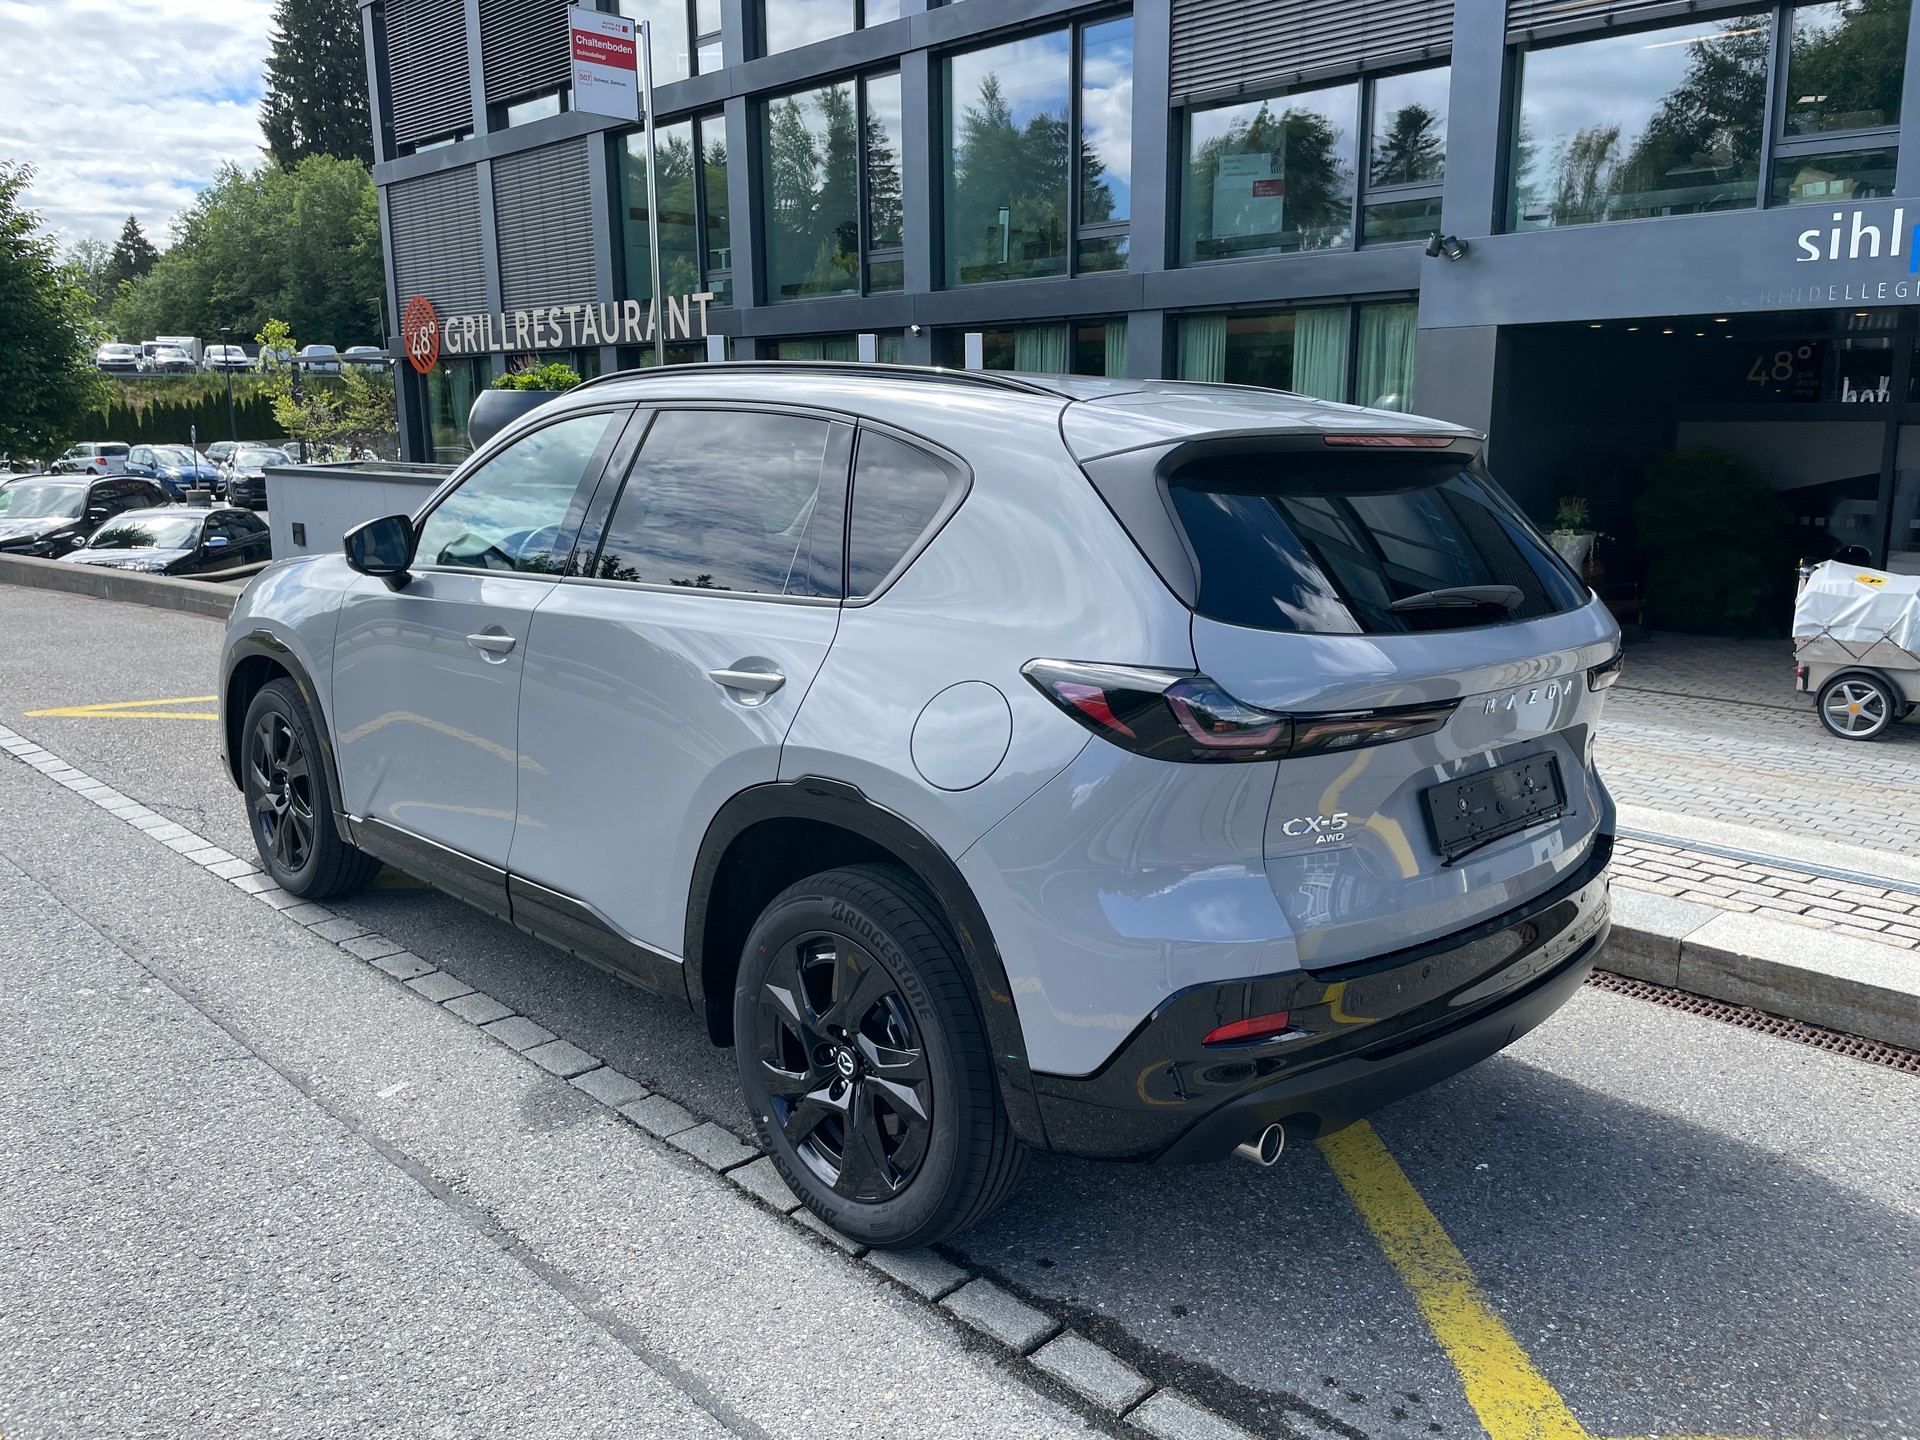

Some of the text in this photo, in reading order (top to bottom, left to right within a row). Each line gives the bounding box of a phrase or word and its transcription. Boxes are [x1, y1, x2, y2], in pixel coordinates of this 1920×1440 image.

[575, 35, 633, 54] Chaltenboden
[576, 49, 606, 60] Schindellegi
[444, 292, 714, 354] GRILLRESTAURANT
[1484, 680, 1574, 715] MAZDA
[1282, 812, 1349, 837] CX-5
[1315, 832, 1345, 844] AWD
[830, 900, 934, 1021] BRIDGESTONE
